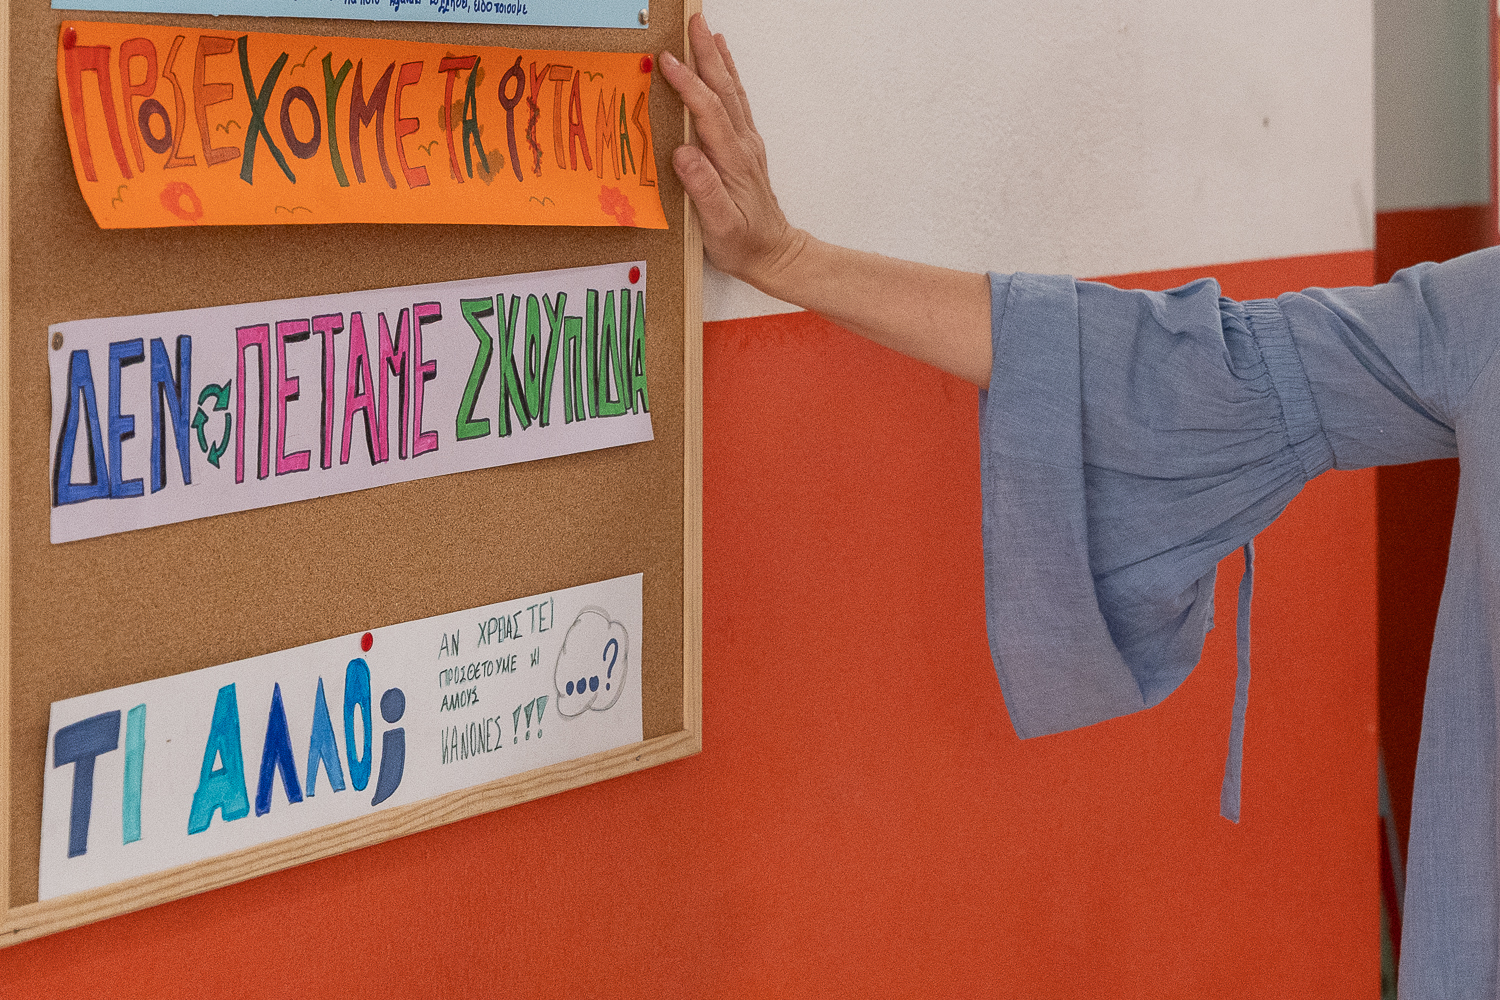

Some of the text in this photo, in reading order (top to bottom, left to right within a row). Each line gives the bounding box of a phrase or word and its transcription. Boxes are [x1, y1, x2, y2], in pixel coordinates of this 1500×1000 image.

[438, 55, 490, 183] ΤΑ
[595, 84, 655, 187] ΜΑΣ
[53, 288, 650, 507] ΔΕΝ ΠΕΤΑΜΕ ΣΚΟΥΠΙΔΙΑ
[438, 629, 459, 660] ΑΝ
[53, 703, 147, 859] ΤΙ
[441, 716, 503, 764] ΚΑΝΟΝΕΣ
